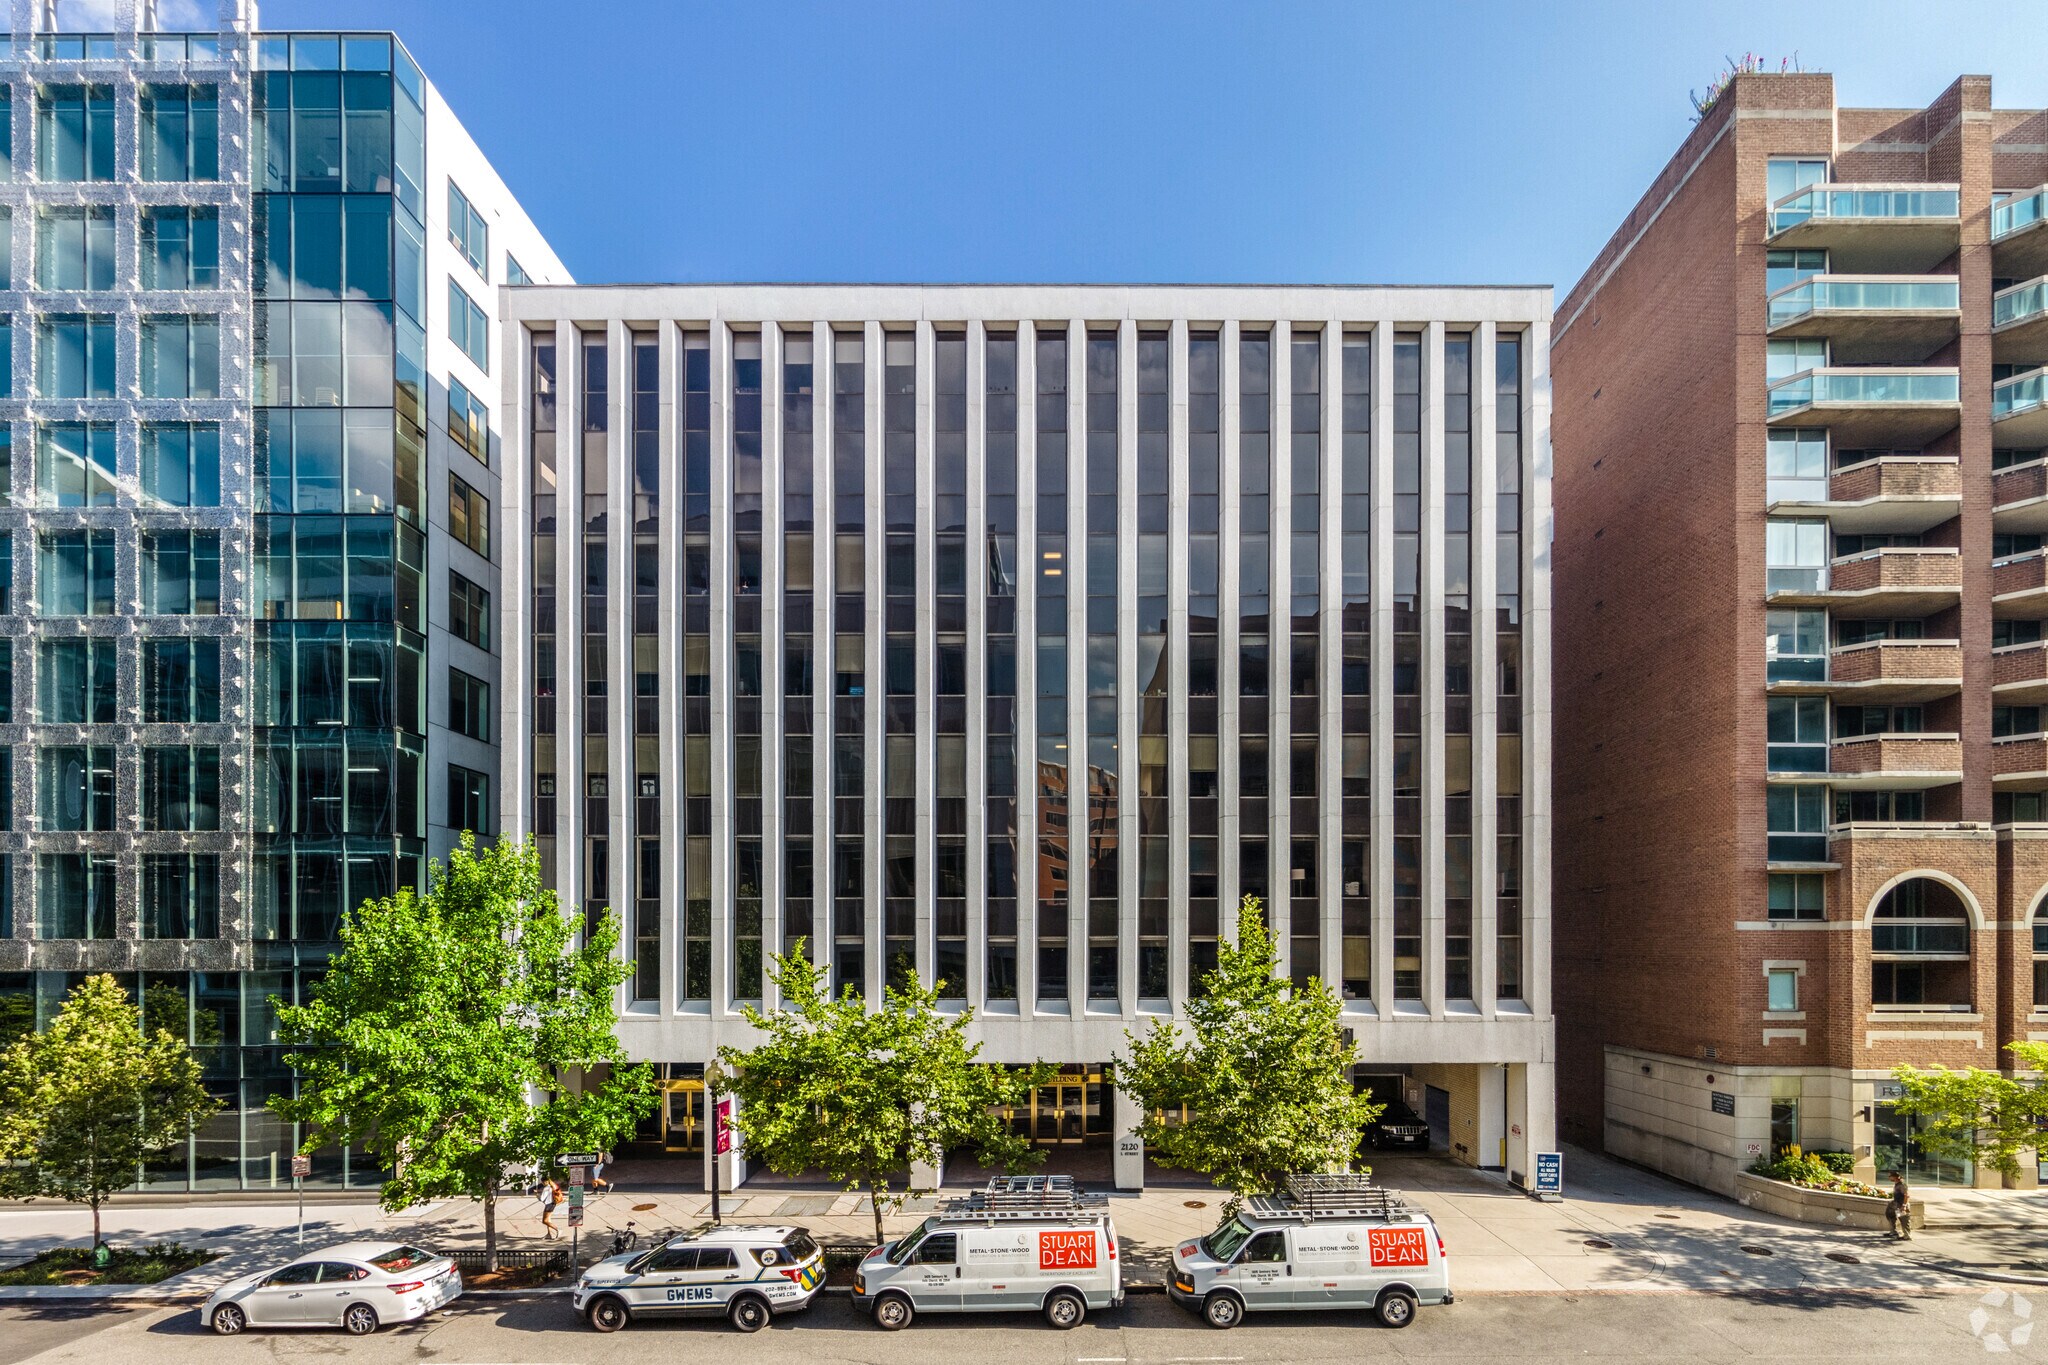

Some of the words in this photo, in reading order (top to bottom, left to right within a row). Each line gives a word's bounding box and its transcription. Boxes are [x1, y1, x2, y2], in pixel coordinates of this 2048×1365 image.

[1121, 1143, 1139, 1151] 2120
[1041, 1234, 1094, 1249] STUART
[1371, 1232, 1423, 1247] STUART
[1042, 1250, 1093, 1266] DEAN
[1373, 1247, 1425, 1263] DEAN
[667, 1287, 713, 1301] GWEMS
